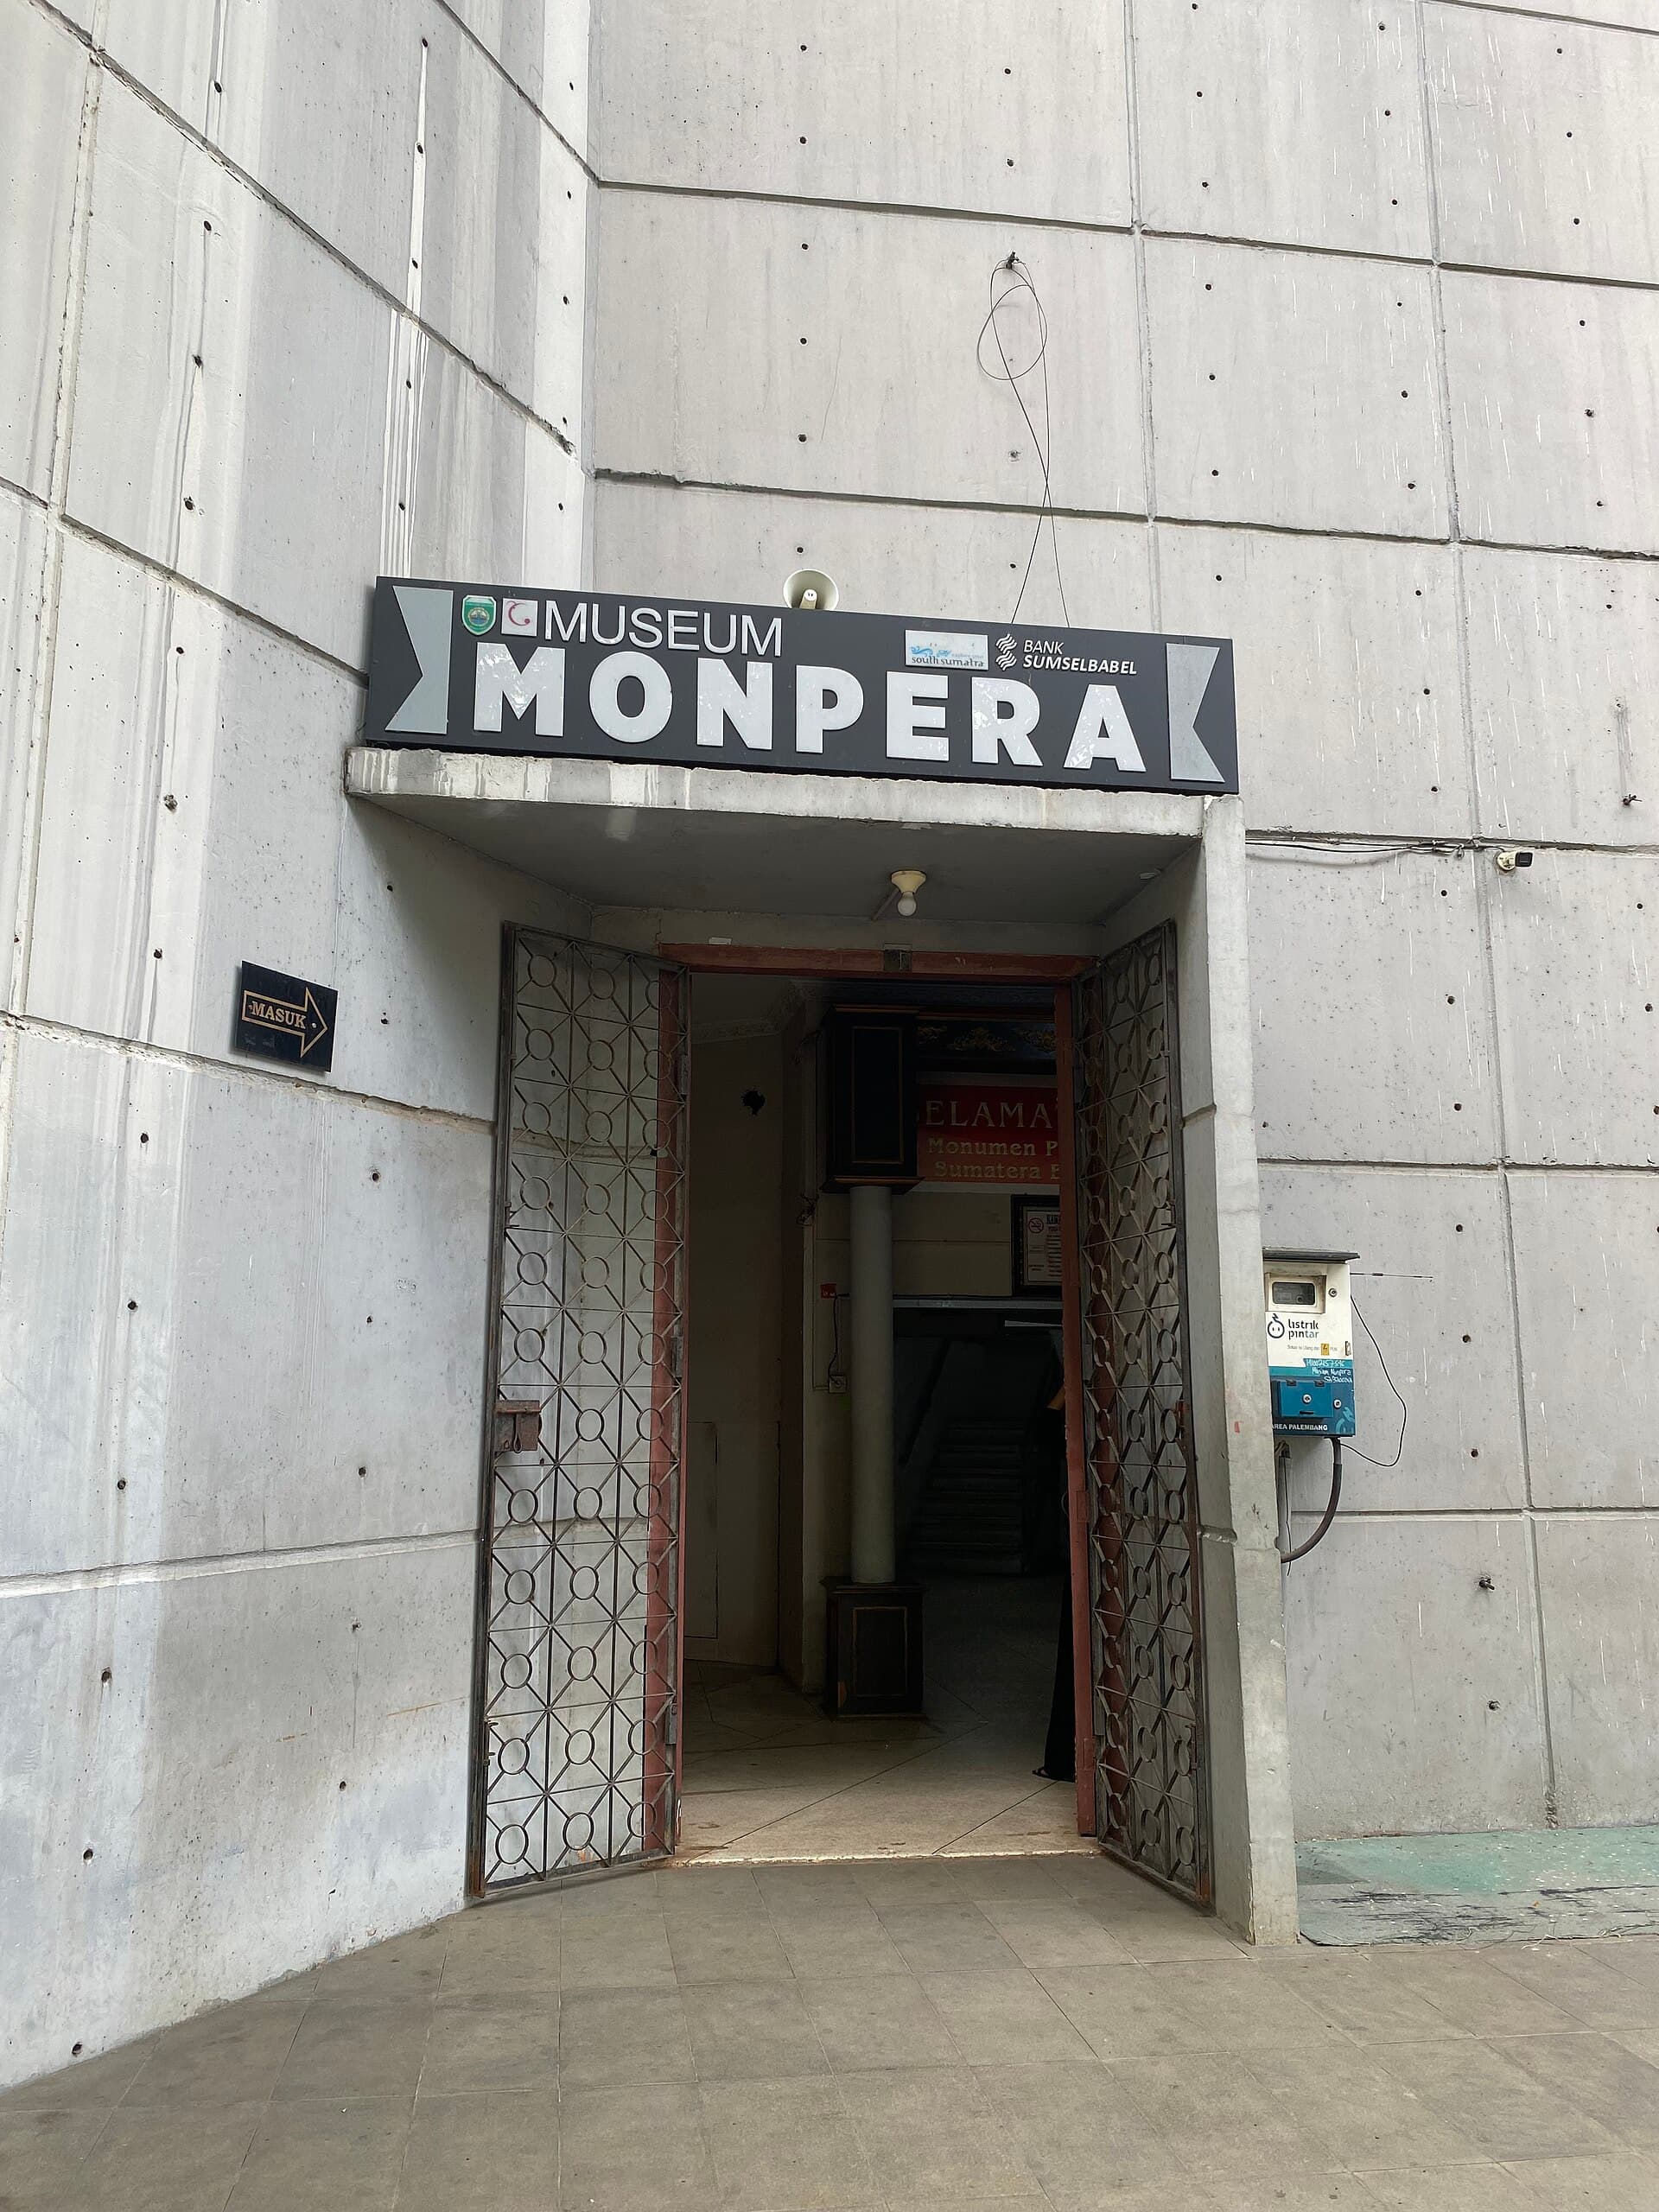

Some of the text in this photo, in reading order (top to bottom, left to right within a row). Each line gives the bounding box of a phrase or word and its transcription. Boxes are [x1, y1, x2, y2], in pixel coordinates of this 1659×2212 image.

[544, 600, 782, 658] MUSEUM
[1023, 639, 1065, 655] BANK
[912, 655, 984, 667] south sumatra
[1023, 655, 1137, 674] SUMSELBABEL
[474, 641, 1147, 772] MONPERA
[251, 1001, 307, 1029] MASUK
[915, 1098, 1058, 1128] ELAMA
[928, 1136, 1058, 1156] Monumen P
[934, 1160, 1043, 1179] Sumatera
[1287, 1319, 1319, 1330] listrik
[1287, 1331, 1319, 1340] pintar
